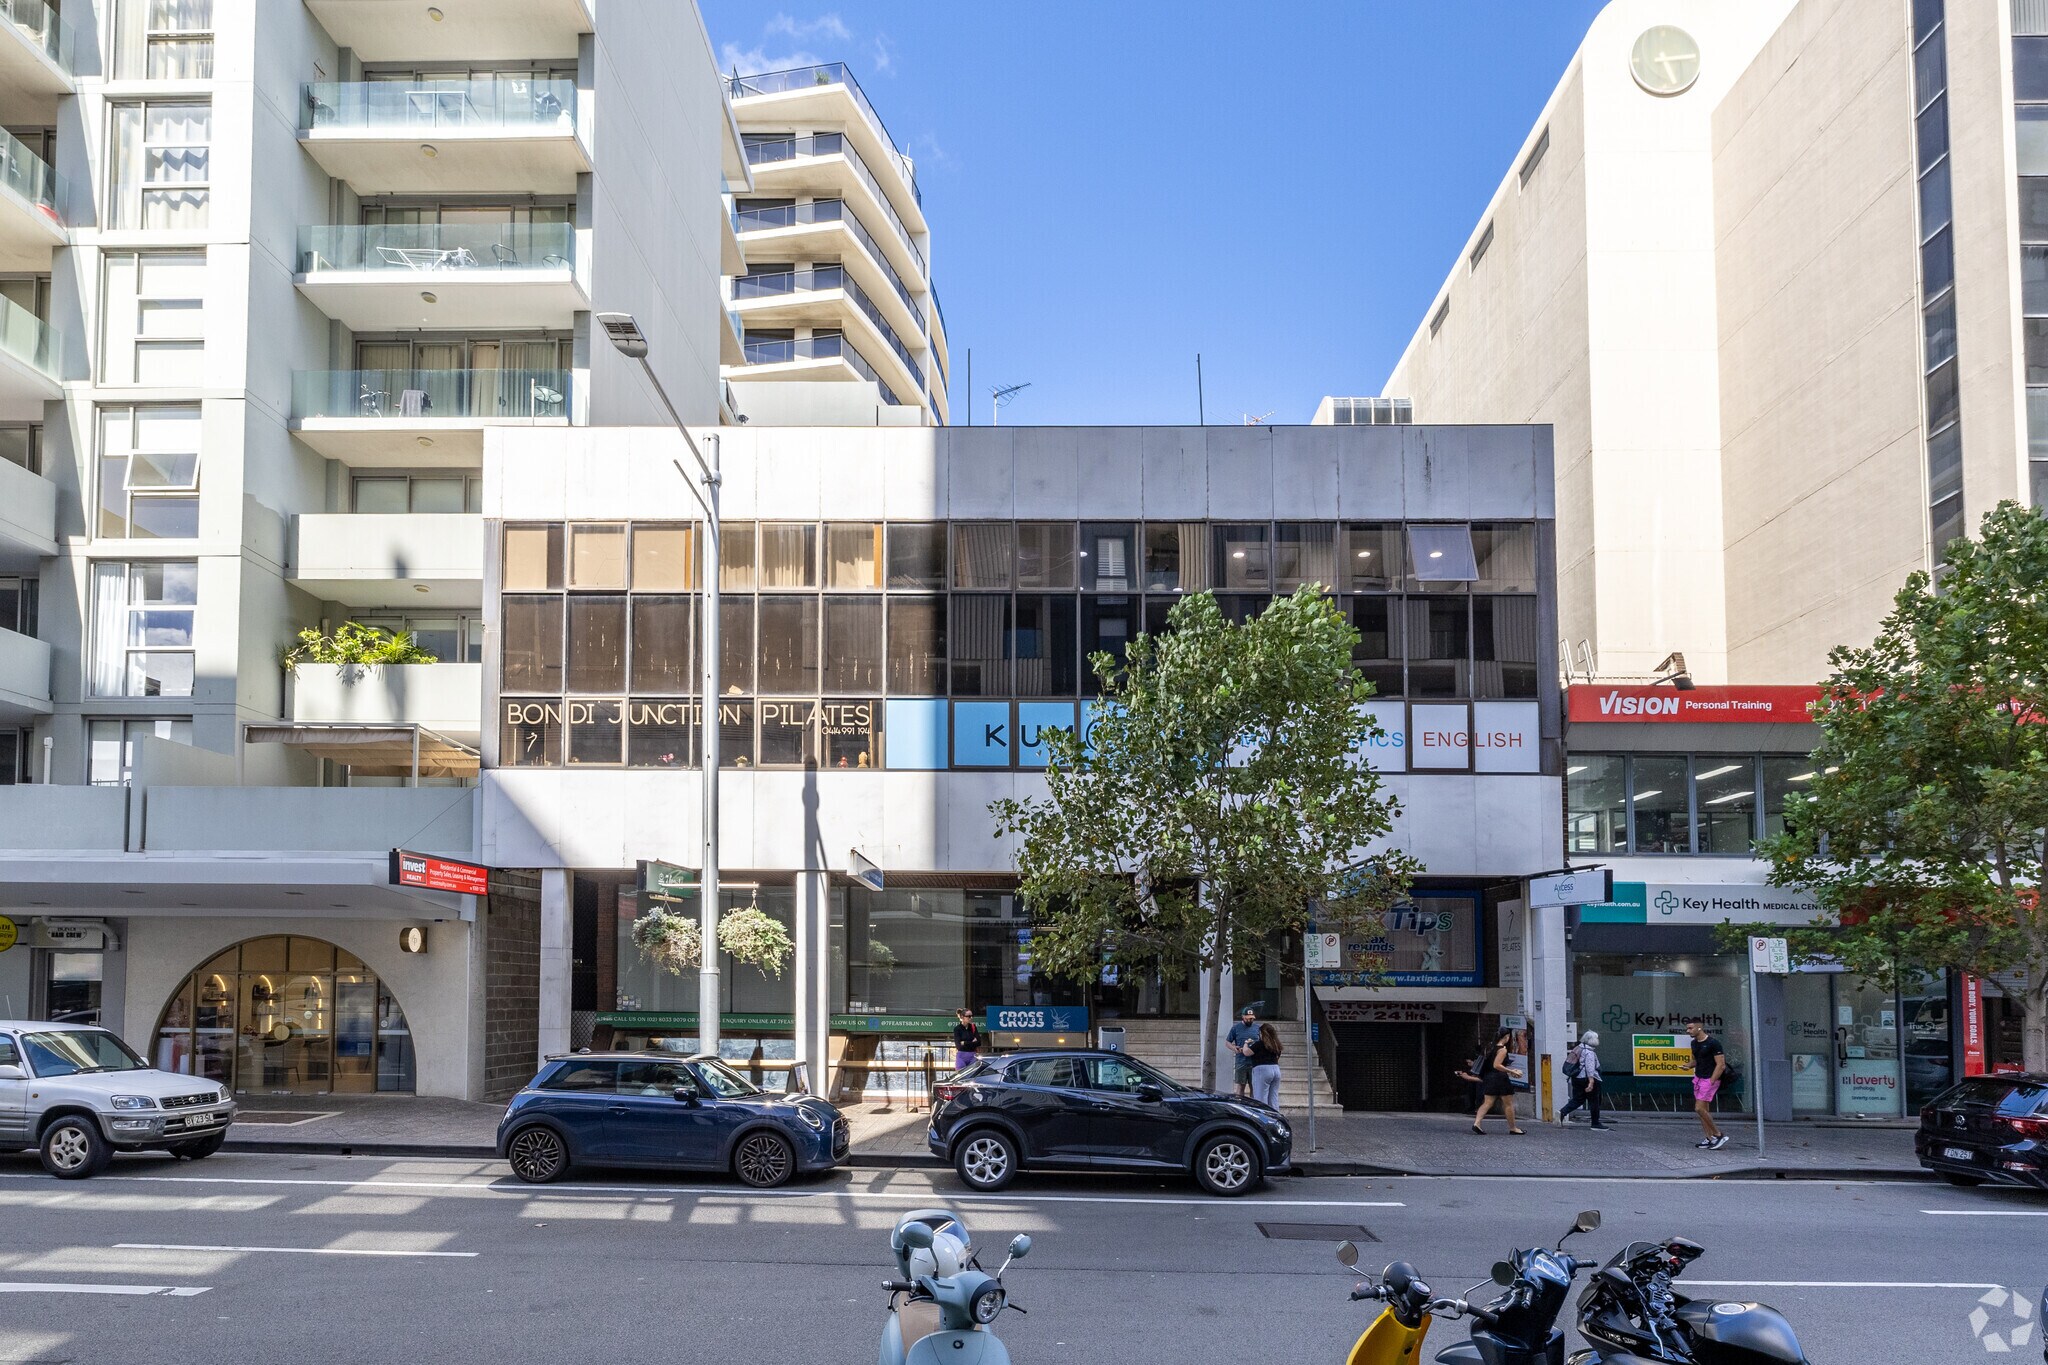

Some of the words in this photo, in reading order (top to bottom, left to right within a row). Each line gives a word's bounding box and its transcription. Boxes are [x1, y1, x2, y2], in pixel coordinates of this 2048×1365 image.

[1600, 690, 1679, 714] VISION
[1685, 700, 1729, 710] Personal
[1731, 700, 1772, 712] Training
[507, 704, 595, 724] BONDI
[608, 704, 740, 725] JUNCTIN
[762, 704, 870, 726] PILATES
[841, 726, 855, 735] 991
[1423, 731, 1522, 748] ENGLISH
[402, 858, 426, 873] invest
[1683, 898, 1709, 912] Key
[1712, 898, 1760, 910] Health
[1365, 936, 1386, 944] ax
[1329, 1001, 1437, 1011] STOPPING
[998, 1011, 1045, 1028] CROSS
[1374, 1011, 1402, 1021] 24
[1405, 1011, 1431, 1021] Hrs.
[1635, 1012, 1664, 1029] Key
[1668, 1013, 1723, 1027] Helth
[1803, 1021, 1817, 1030] Key
[1638, 1052, 1660, 1062] Bulk
[1661, 1052, 1690, 1063] Billing
[1639, 1061, 1678, 1071] Practice
[1852, 1073, 1896, 1089] laverty
